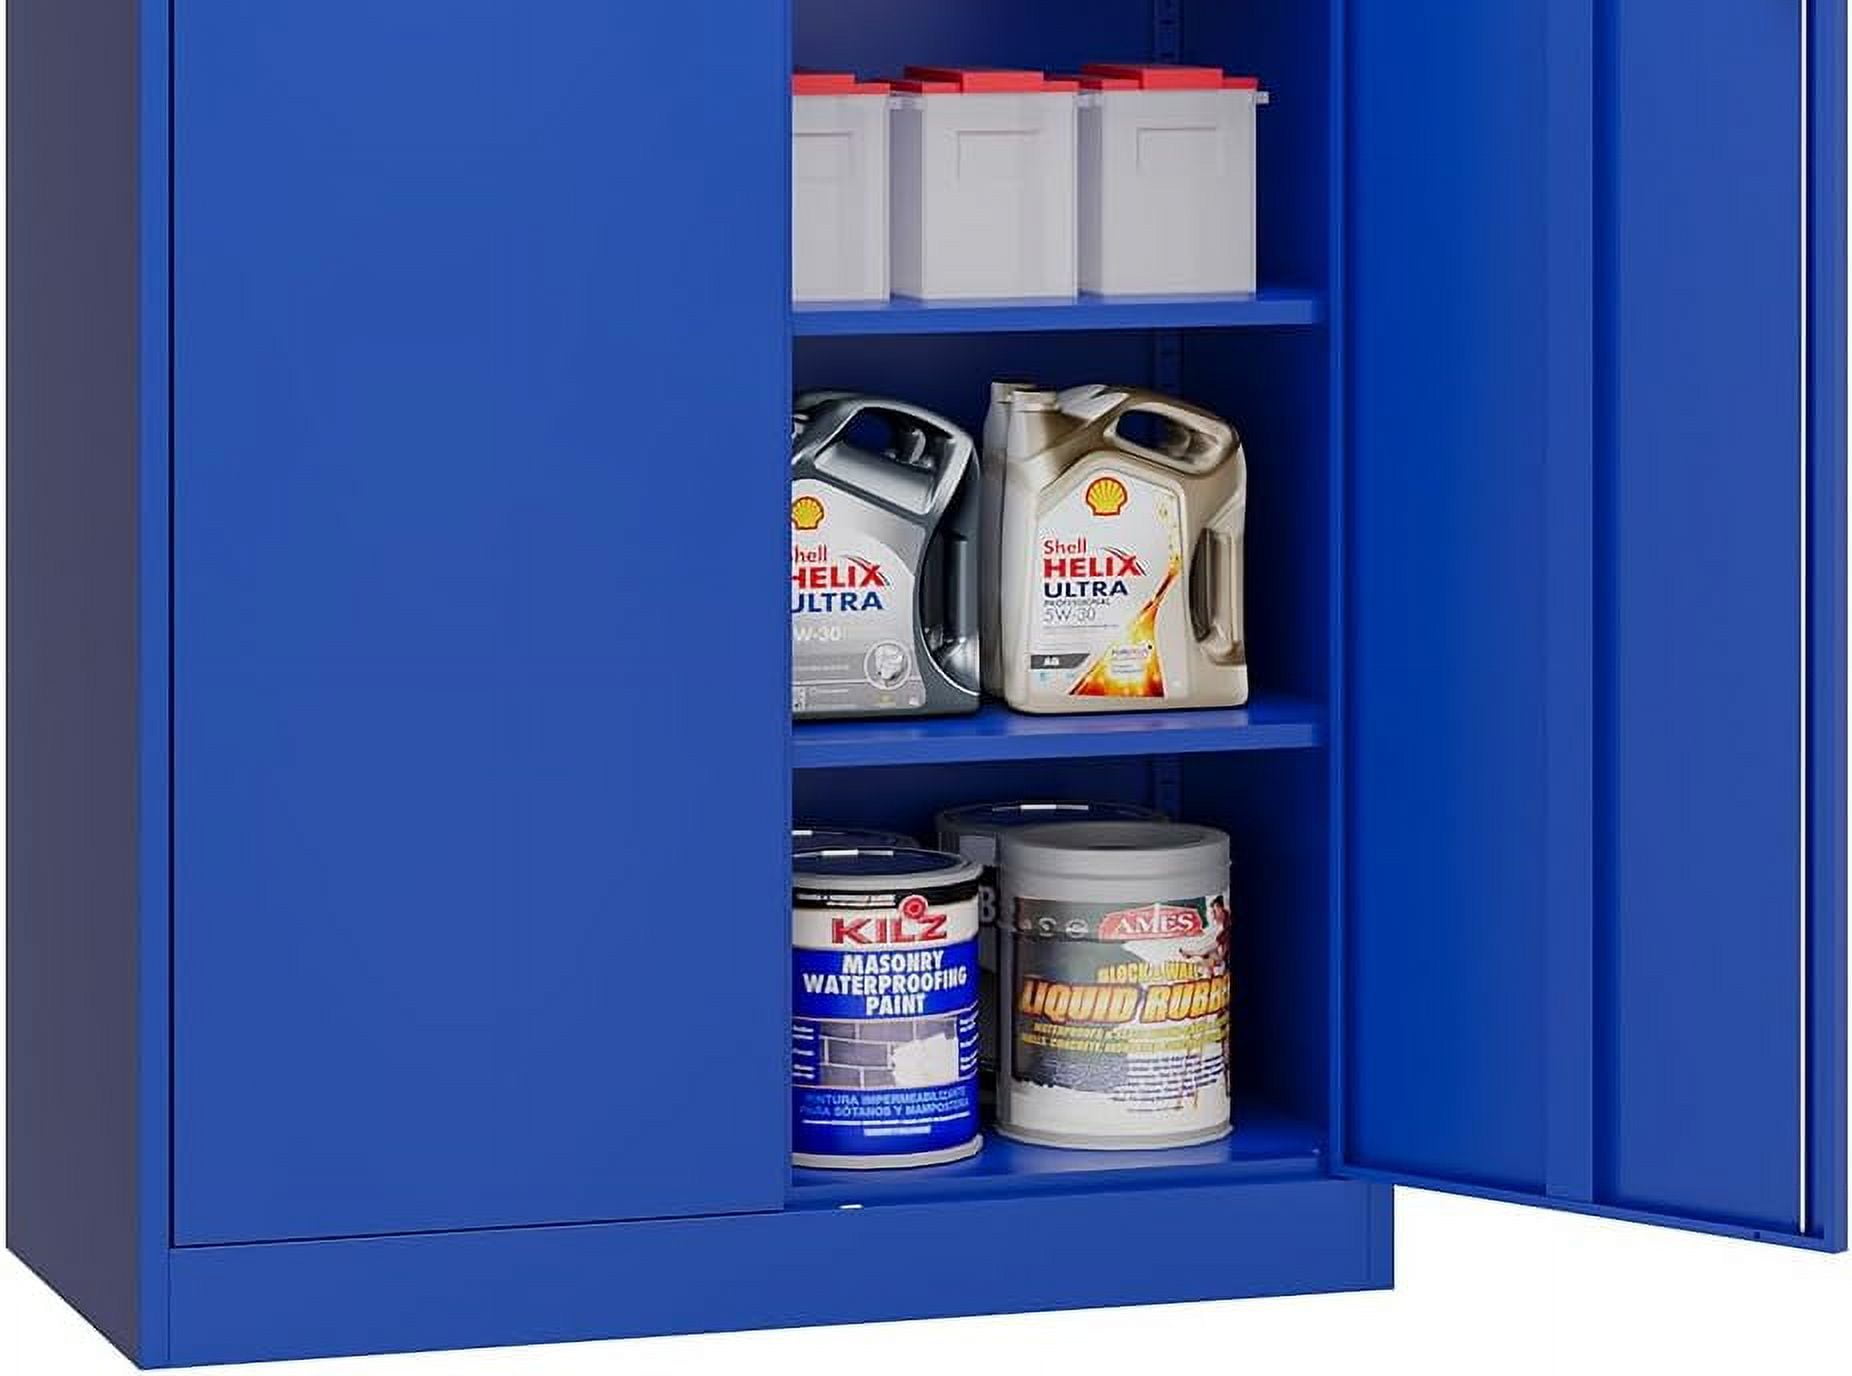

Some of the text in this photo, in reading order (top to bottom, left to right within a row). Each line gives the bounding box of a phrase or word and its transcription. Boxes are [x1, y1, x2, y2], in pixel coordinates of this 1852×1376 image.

[793, 544, 828, 564] hell
[1043, 537, 1087, 555] Shell
[1043, 555, 1143, 578] HELIX
[1044, 580, 1129, 598] ULTRA
[1043, 608, 1096, 622] 5W-30
[831, 904, 948, 944] KILZ
[1116, 912, 1194, 933] AMES
[842, 950, 944, 975] MASONRY
[803, 966, 968, 996] WATERPROOFING
[865, 992, 926, 1015] PAINT
[1023, 980, 1141, 1023] LIQUID
